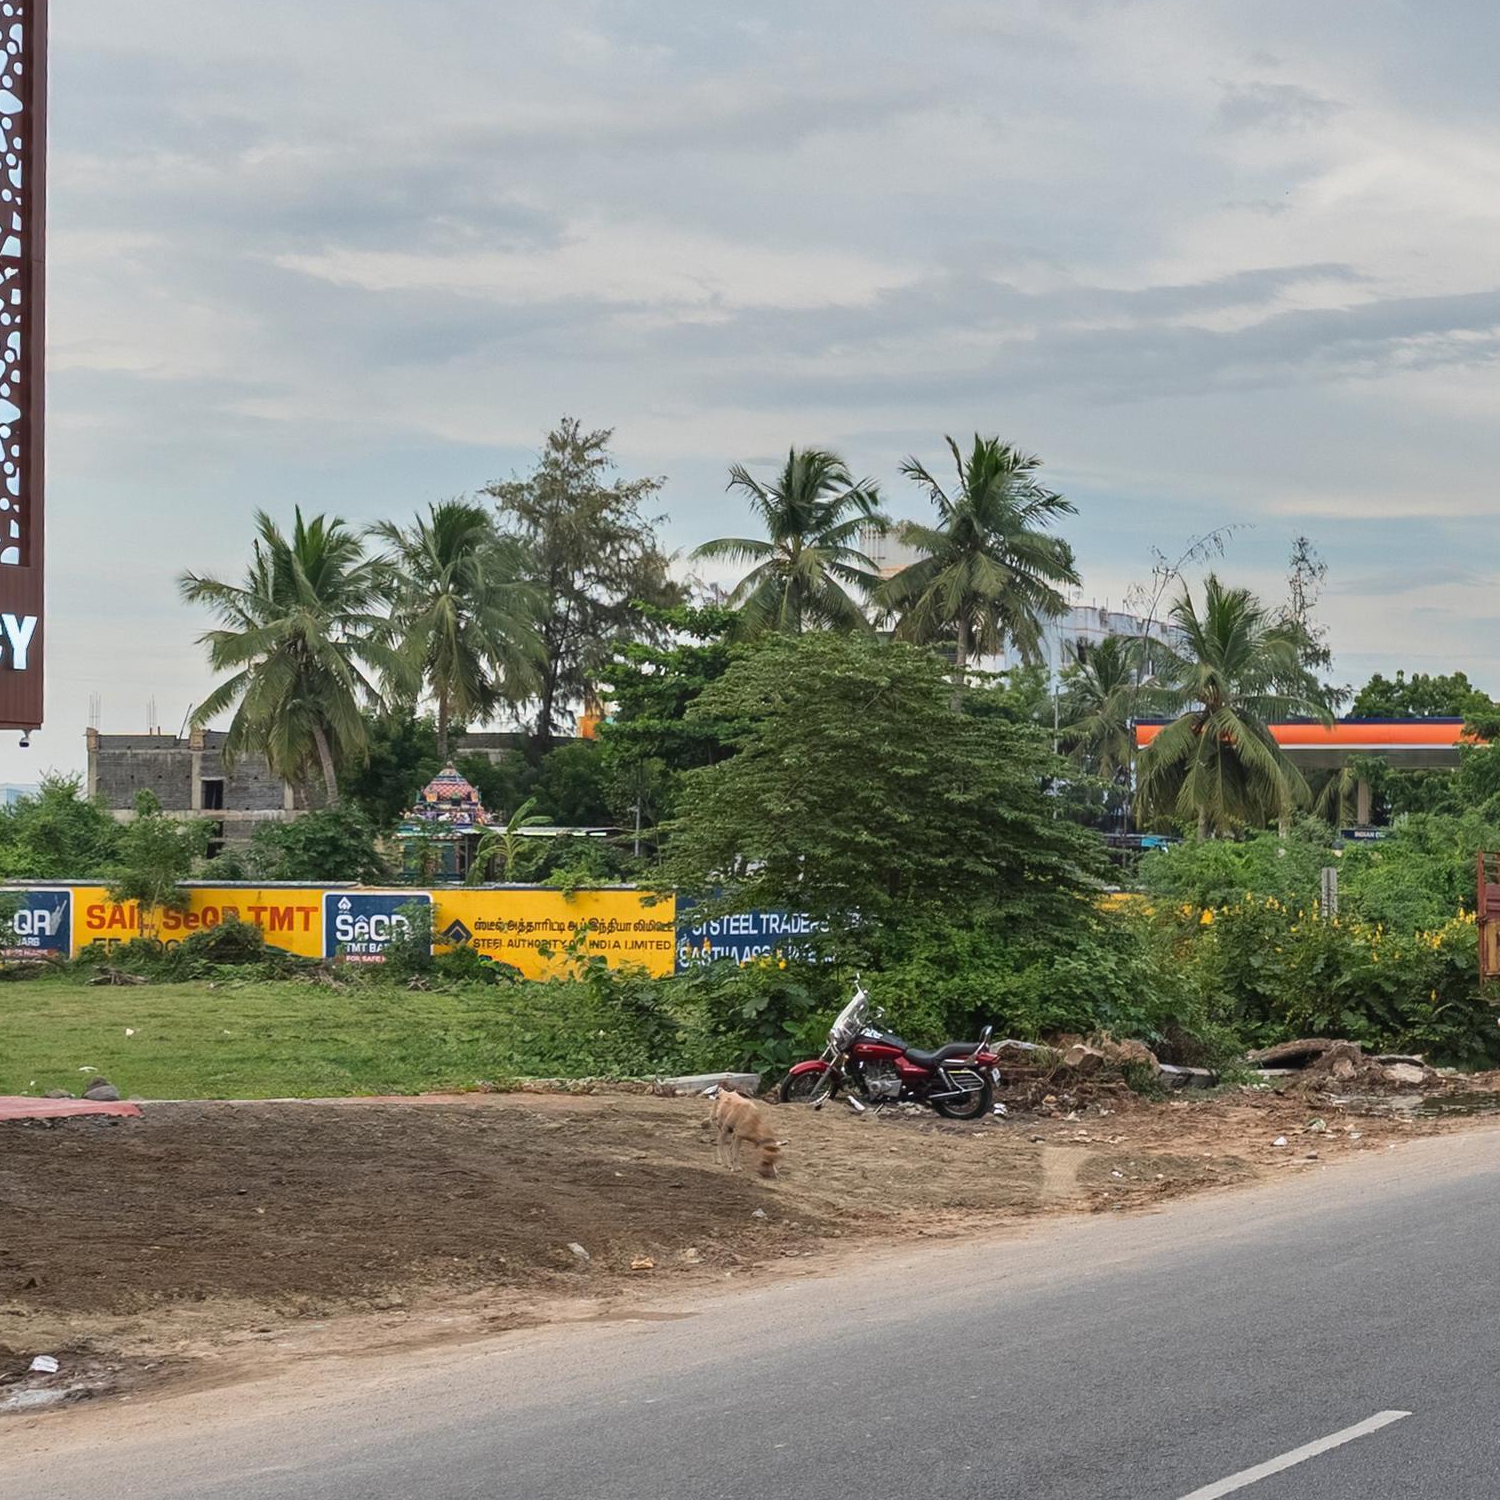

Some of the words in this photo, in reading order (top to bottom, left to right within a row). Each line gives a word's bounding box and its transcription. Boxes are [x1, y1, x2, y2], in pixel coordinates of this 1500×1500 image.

[248, 906, 318, 932] TMT
[709, 914, 758, 935] STEEL
[625, 940, 671, 950] LIMITED
